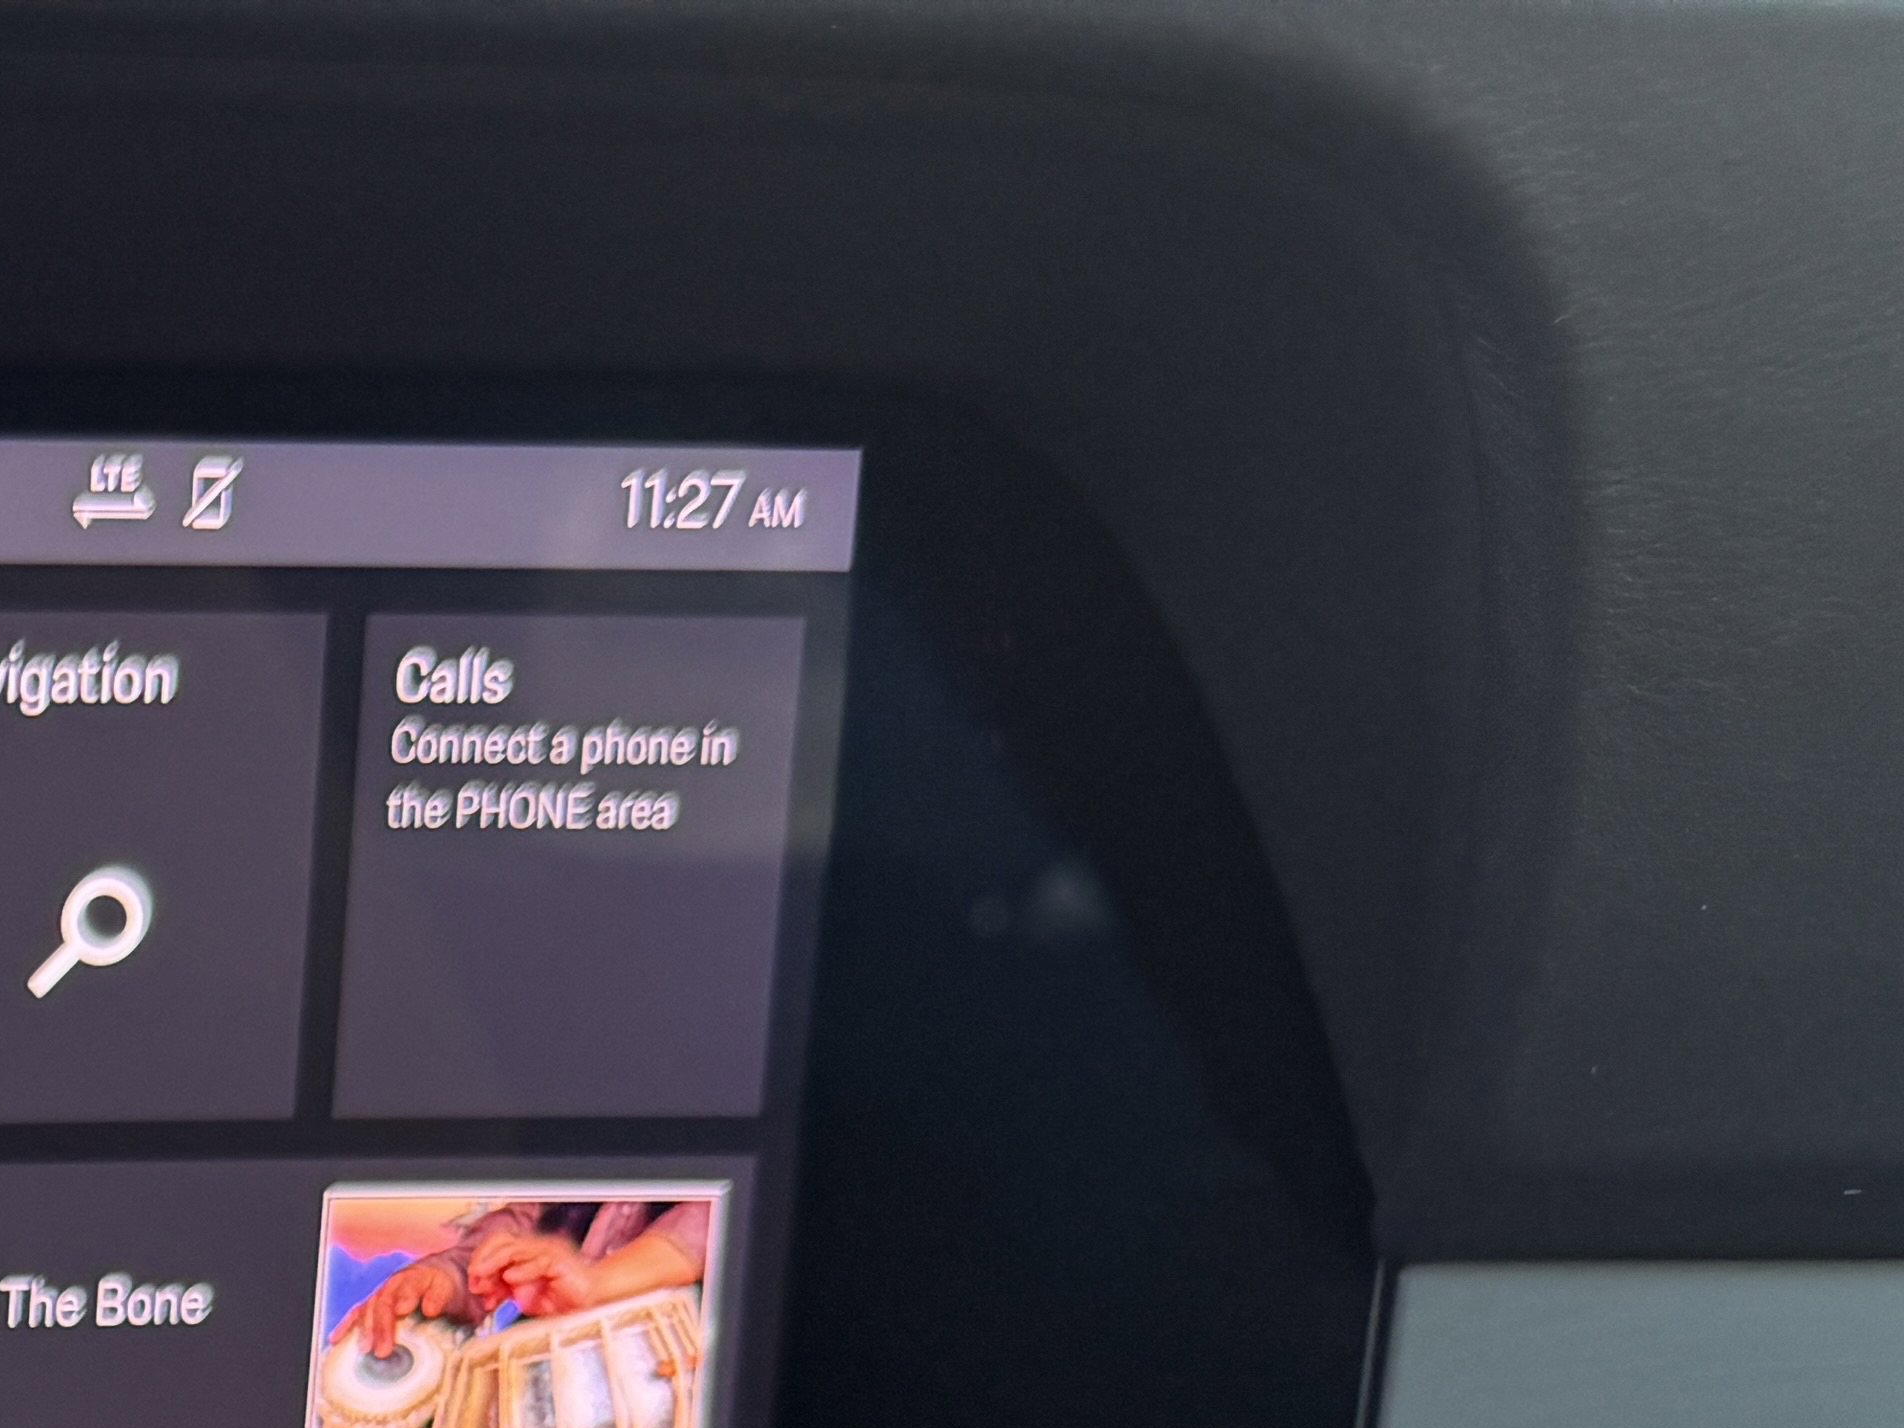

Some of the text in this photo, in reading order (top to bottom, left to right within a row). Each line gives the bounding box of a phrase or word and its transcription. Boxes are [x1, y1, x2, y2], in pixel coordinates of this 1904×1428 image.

[90, 454, 143, 492] LTE
[622, 468, 808, 530] 11:27 AM
[394, 647, 515, 706] Calls
[390, 716, 738, 774] Connect a phone in
[385, 782, 680, 830] the PHONE area
[0, 1276, 86, 1328] The
[96, 1272, 213, 1326] Bone
